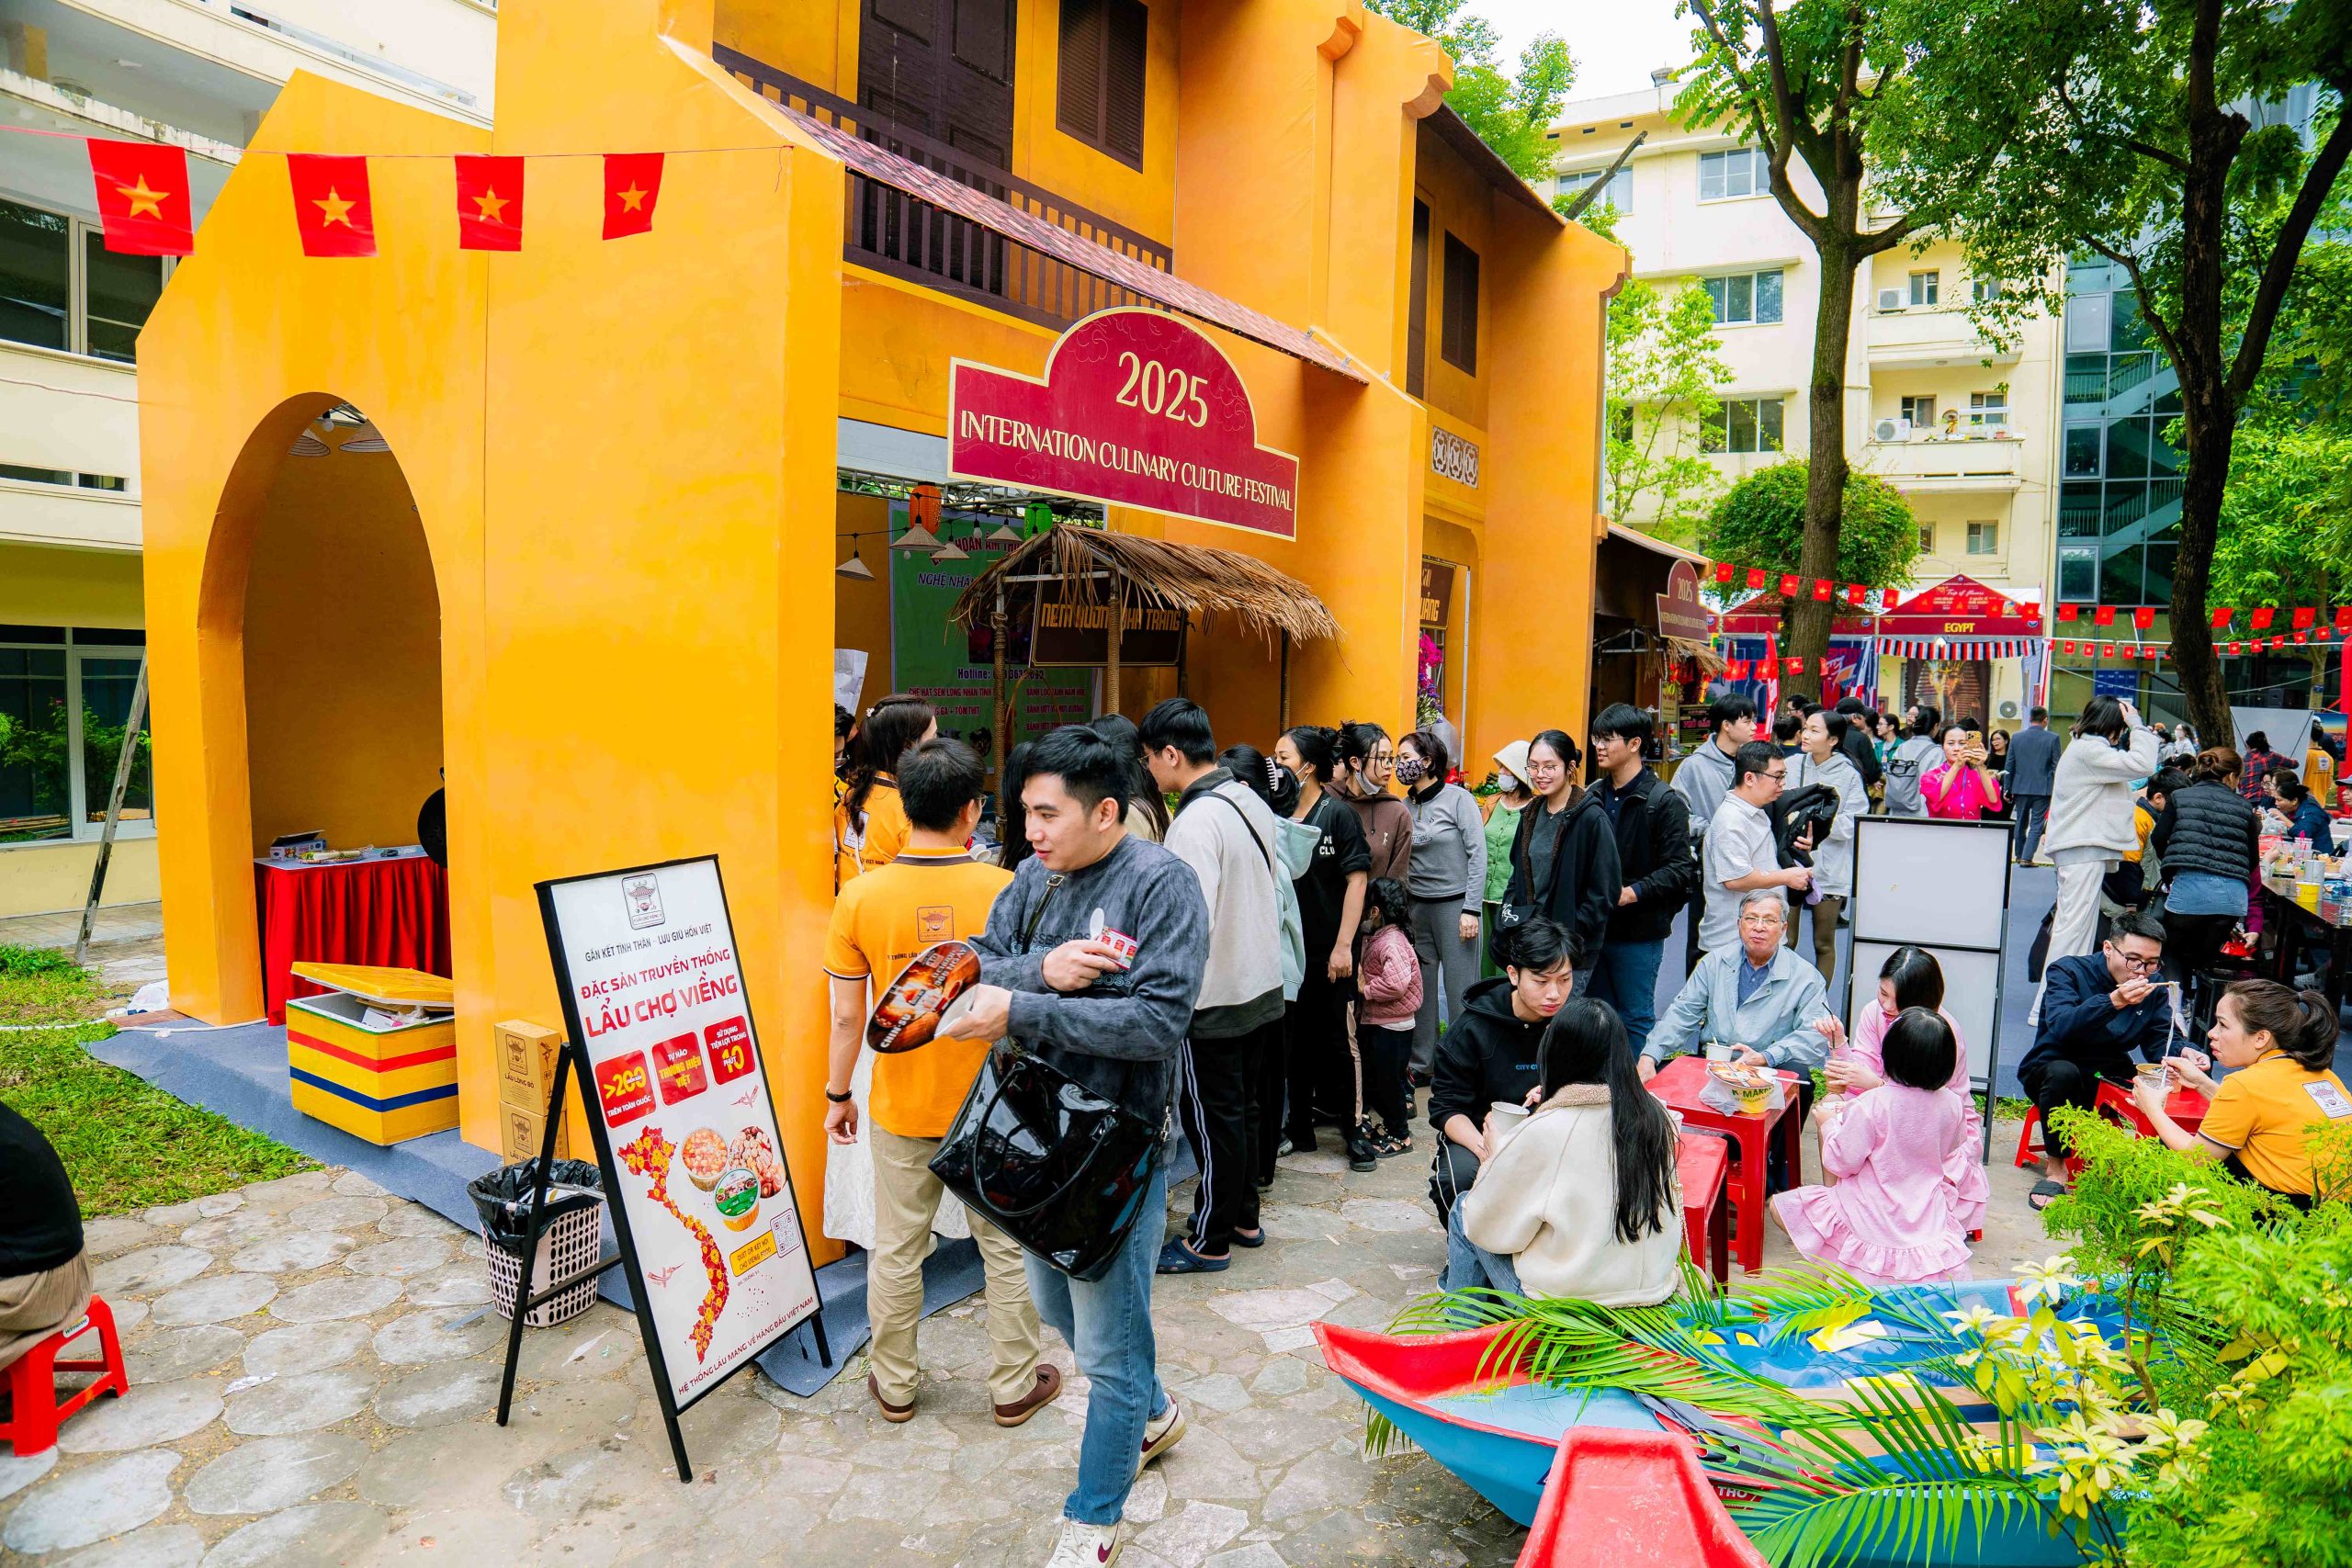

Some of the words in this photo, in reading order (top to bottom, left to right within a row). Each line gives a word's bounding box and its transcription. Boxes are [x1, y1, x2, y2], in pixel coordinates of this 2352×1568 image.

[1115, 350, 1209, 428] 2025
[960, 410, 1096, 465] INTERNATION
[1099, 441, 1181, 484] CULINARY
[1181, 462, 1243, 499] CULTURE
[1244, 479, 1293, 512] FESTIVAL
[949, 574, 972, 589] NHÂ
[1944, 623, 1975, 633] EGYPT
[957, 668, 990, 680] Hotline:
[581, 979, 609, 999] ĐẶC
[610, 971, 638, 992] SẢN
[639, 955, 689, 982] TRUYỀN
[690, 946, 730, 969] THỐNG
[585, 997, 630, 1038] LẨU
[634, 987, 678, 1022] CHỢ
[679, 970, 738, 1008] VIỀNG
[729, 1032, 747, 1043] TRONG
[721, 1044, 745, 1074] 10
[723, 1055, 737, 1067] PHÚT
[606, 1105, 622, 1118] TRÊN
[621, 1101, 636, 1112] TOÀN
[678, 1382, 690, 1395] HỆ
[689, 1369, 714, 1387] THỐNG
[728, 1343, 748, 1361] MANG
[756, 1324, 775, 1342] HÀNG
[799, 1296, 814, 1310] NAM
